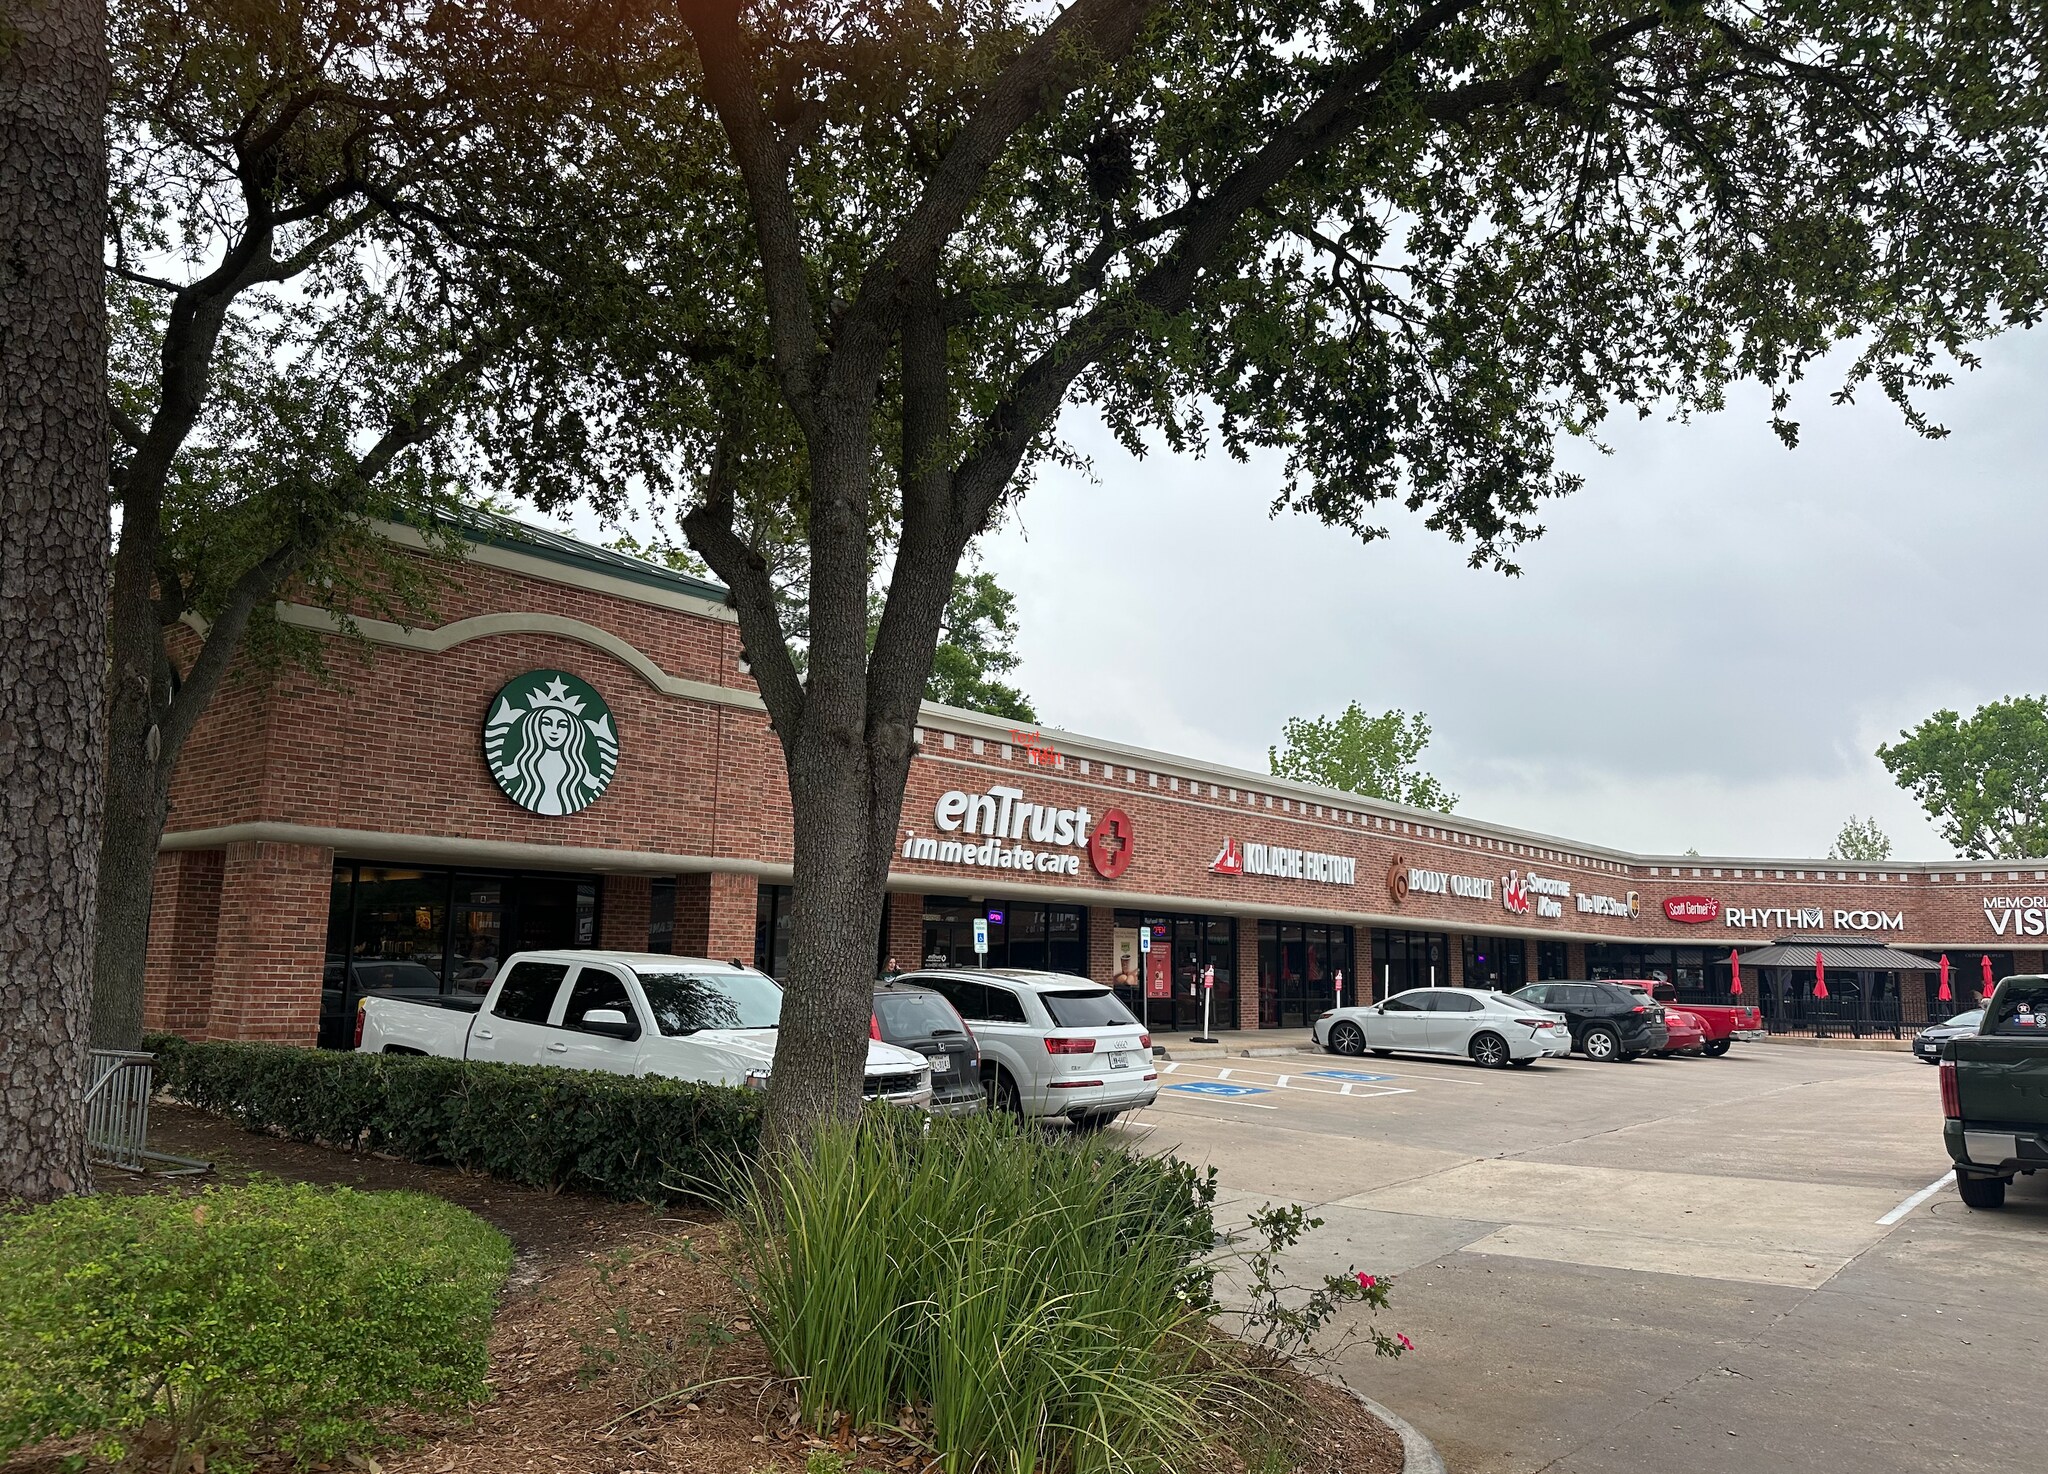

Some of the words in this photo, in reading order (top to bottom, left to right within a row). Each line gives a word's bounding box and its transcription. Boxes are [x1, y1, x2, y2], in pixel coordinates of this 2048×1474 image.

[934, 785, 1092, 848] enTrust
[901, 830, 1034, 871] immediate
[1034, 852, 1080, 875] care
[1243, 842, 1303, 879] KOLACHE
[1302, 851, 1356, 885] FACTORY
[1408, 868, 1449, 894] BODY
[1450, 874, 1494, 900] ORBIT
[1576, 893, 1592, 913] The
[1592, 894, 1611, 916] UPS
[1609, 896, 1628, 918] Store
[1669, 902, 1685, 916] Scott
[1726, 907, 1824, 929] RHYTHM
[1834, 909, 1904, 930] ROOM
